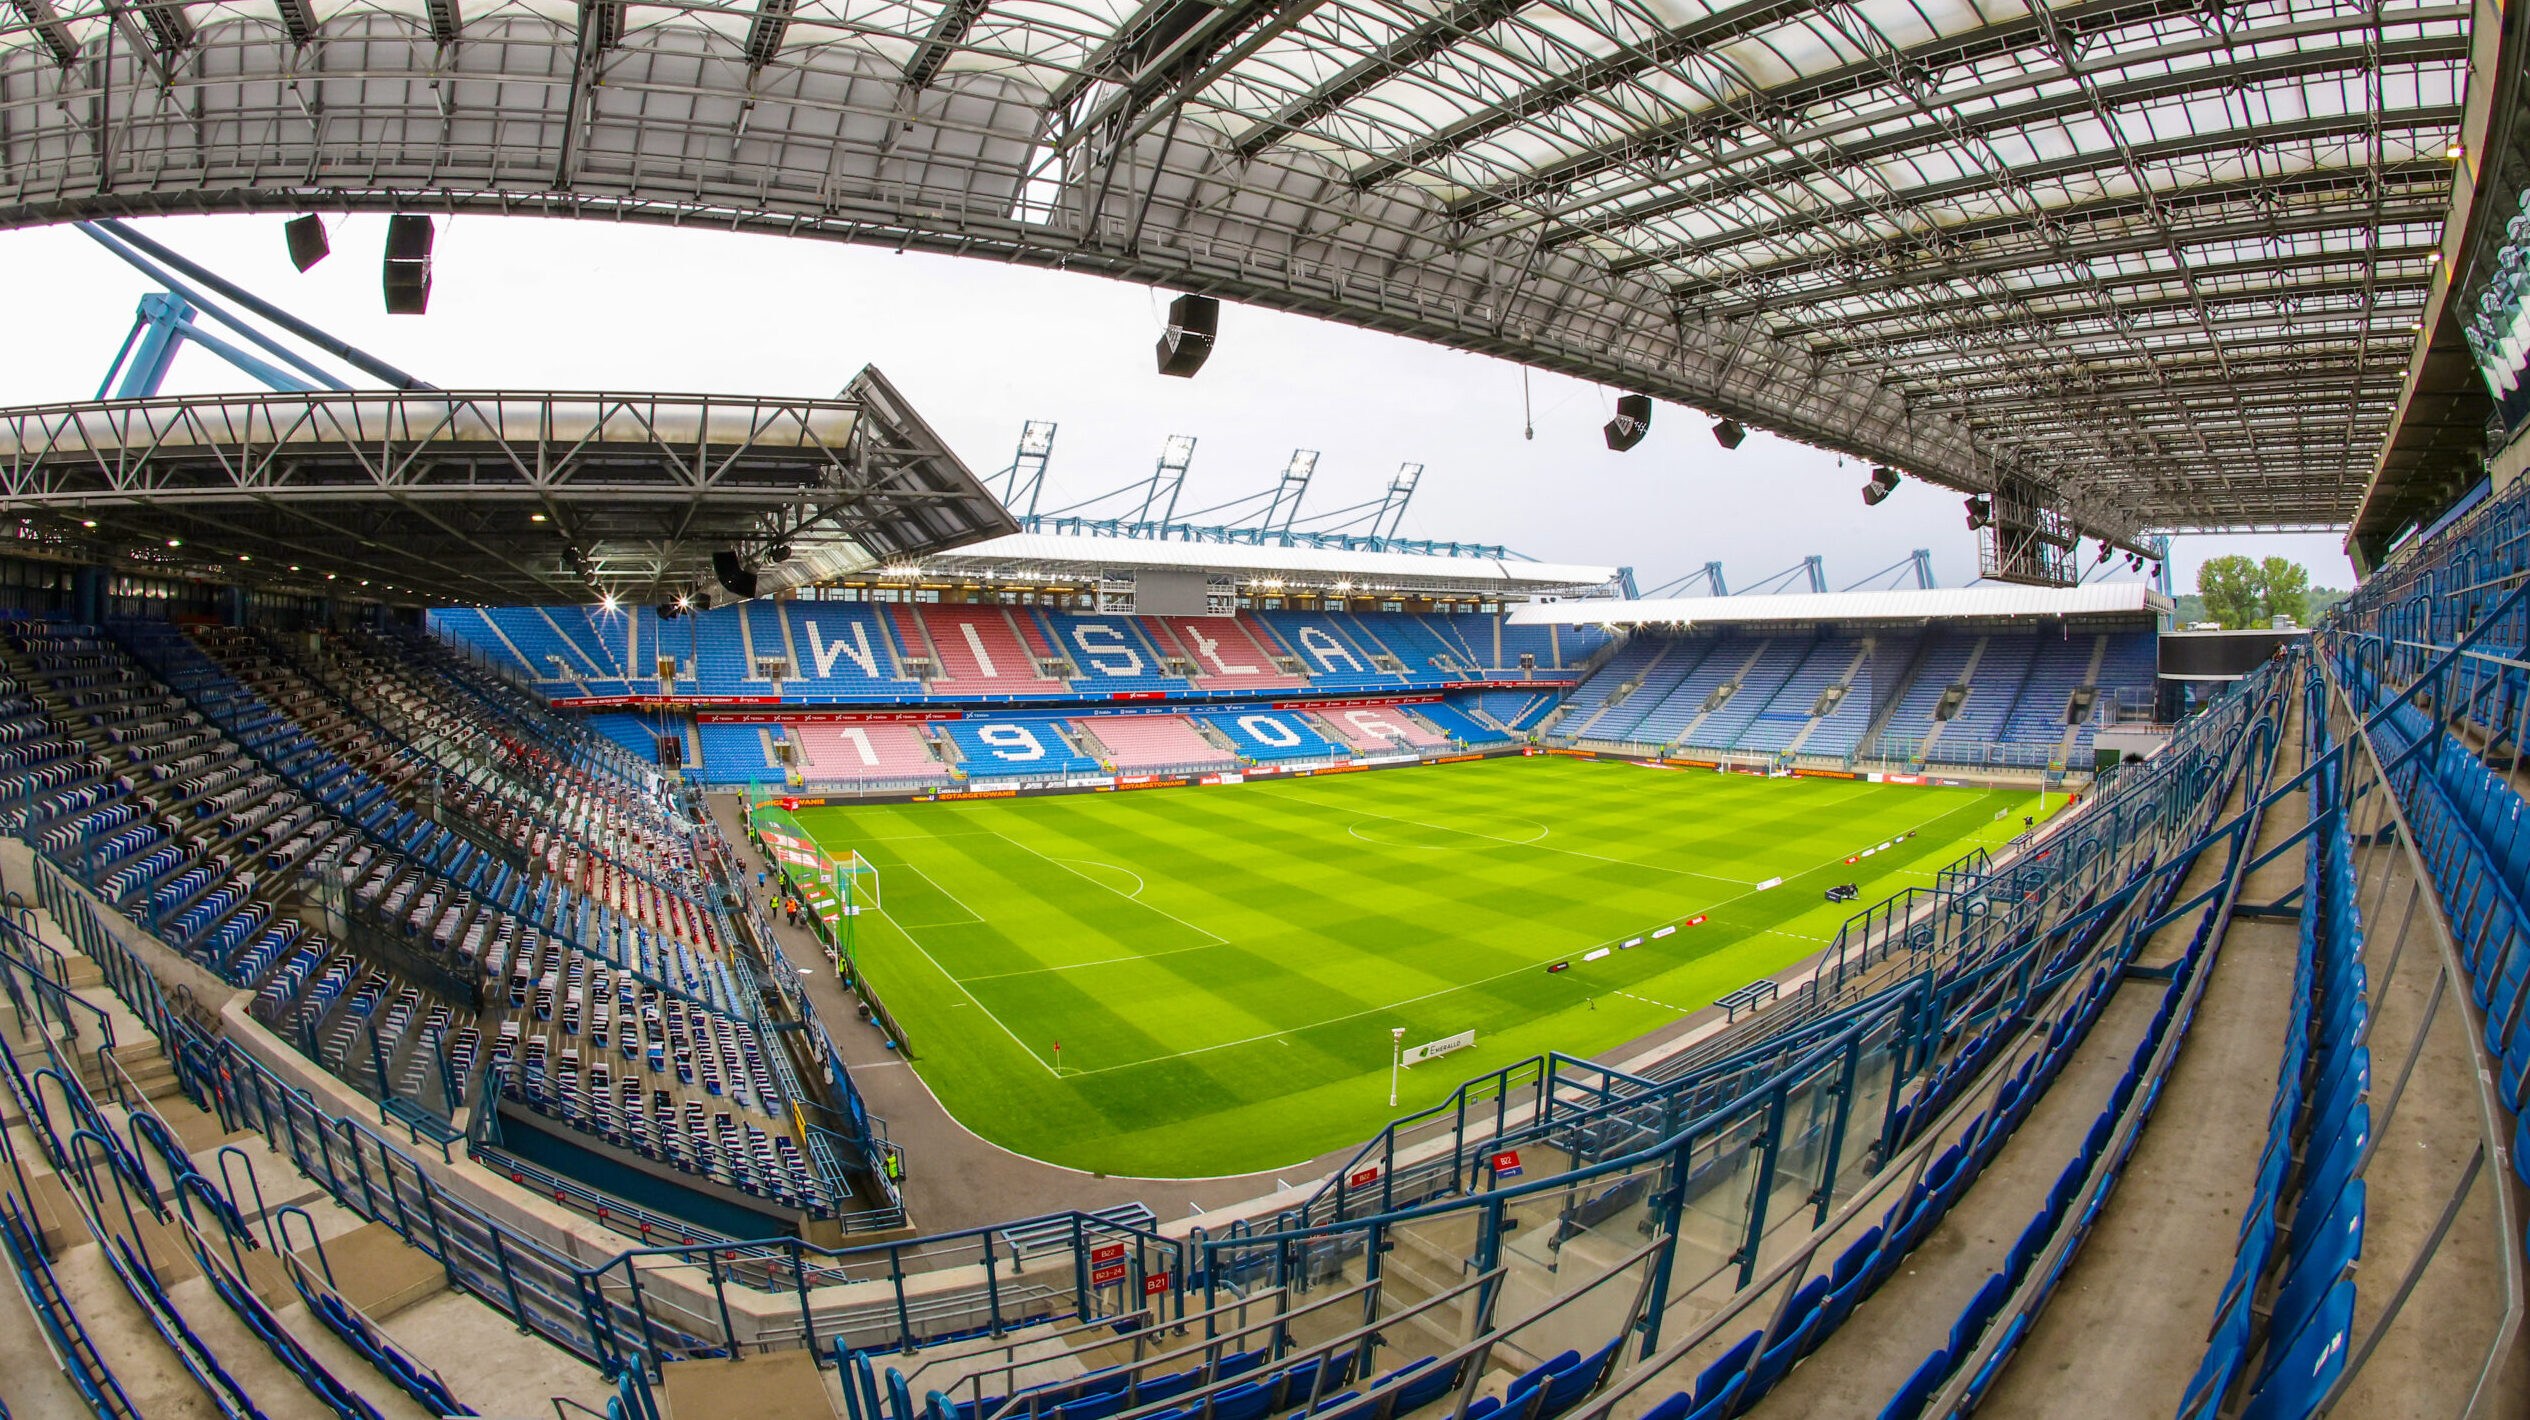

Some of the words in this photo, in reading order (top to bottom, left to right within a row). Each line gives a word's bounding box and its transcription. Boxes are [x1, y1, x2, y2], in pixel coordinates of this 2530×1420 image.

[1500, 1156, 1512, 1166] B22
[1101, 1248, 1115, 1258] B22
[1147, 1278, 1166, 1290] B21
